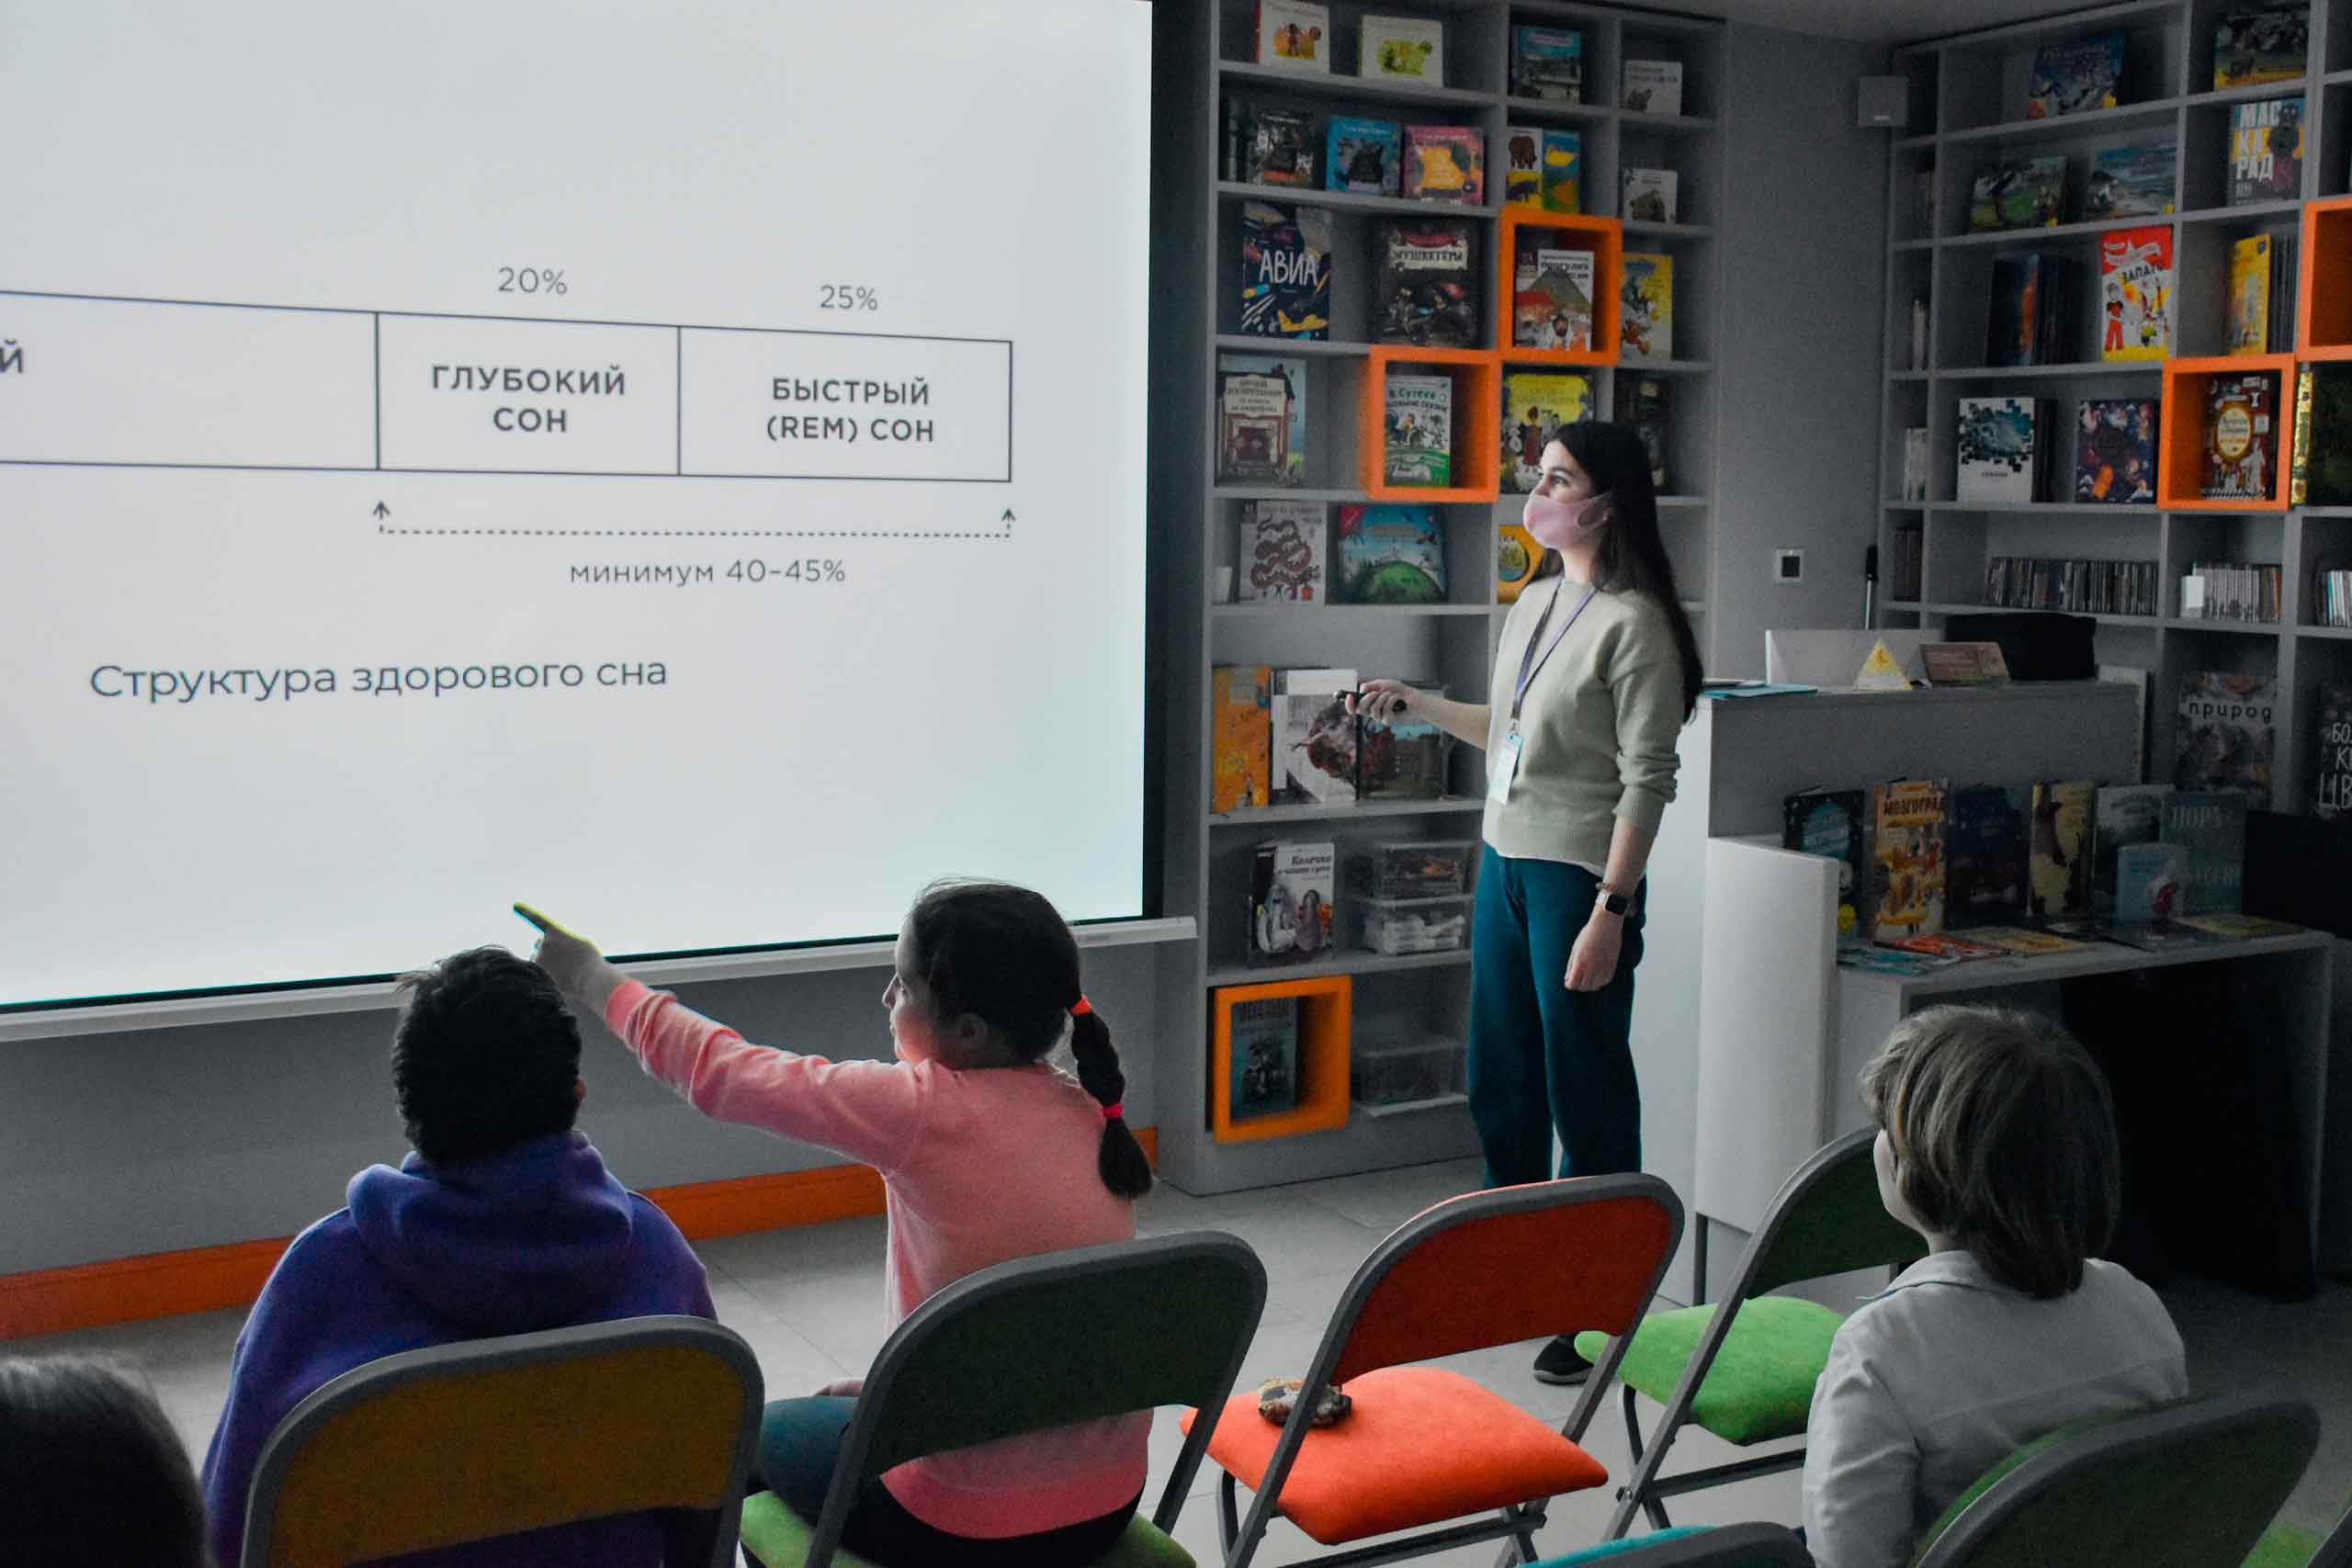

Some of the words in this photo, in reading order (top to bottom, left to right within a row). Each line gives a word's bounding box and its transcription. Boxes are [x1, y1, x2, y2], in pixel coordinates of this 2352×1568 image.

[499, 266, 568, 295] 20%
[820, 285, 878, 311] 25%
[432, 365, 626, 396] ГЛУБОКИЙ
[772, 377, 930, 406] БЫСТРЫЙ
[492, 406, 568, 434] СОН
[766, 415, 858, 444] (REM)
[870, 418, 934, 443] СОН
[570, 564, 714, 589] минимум
[90, 664, 336, 705] Структура
[353, 664, 584, 698] здорового
[596, 662, 667, 687] сна
[2331, 722, 2352, 743] БО
